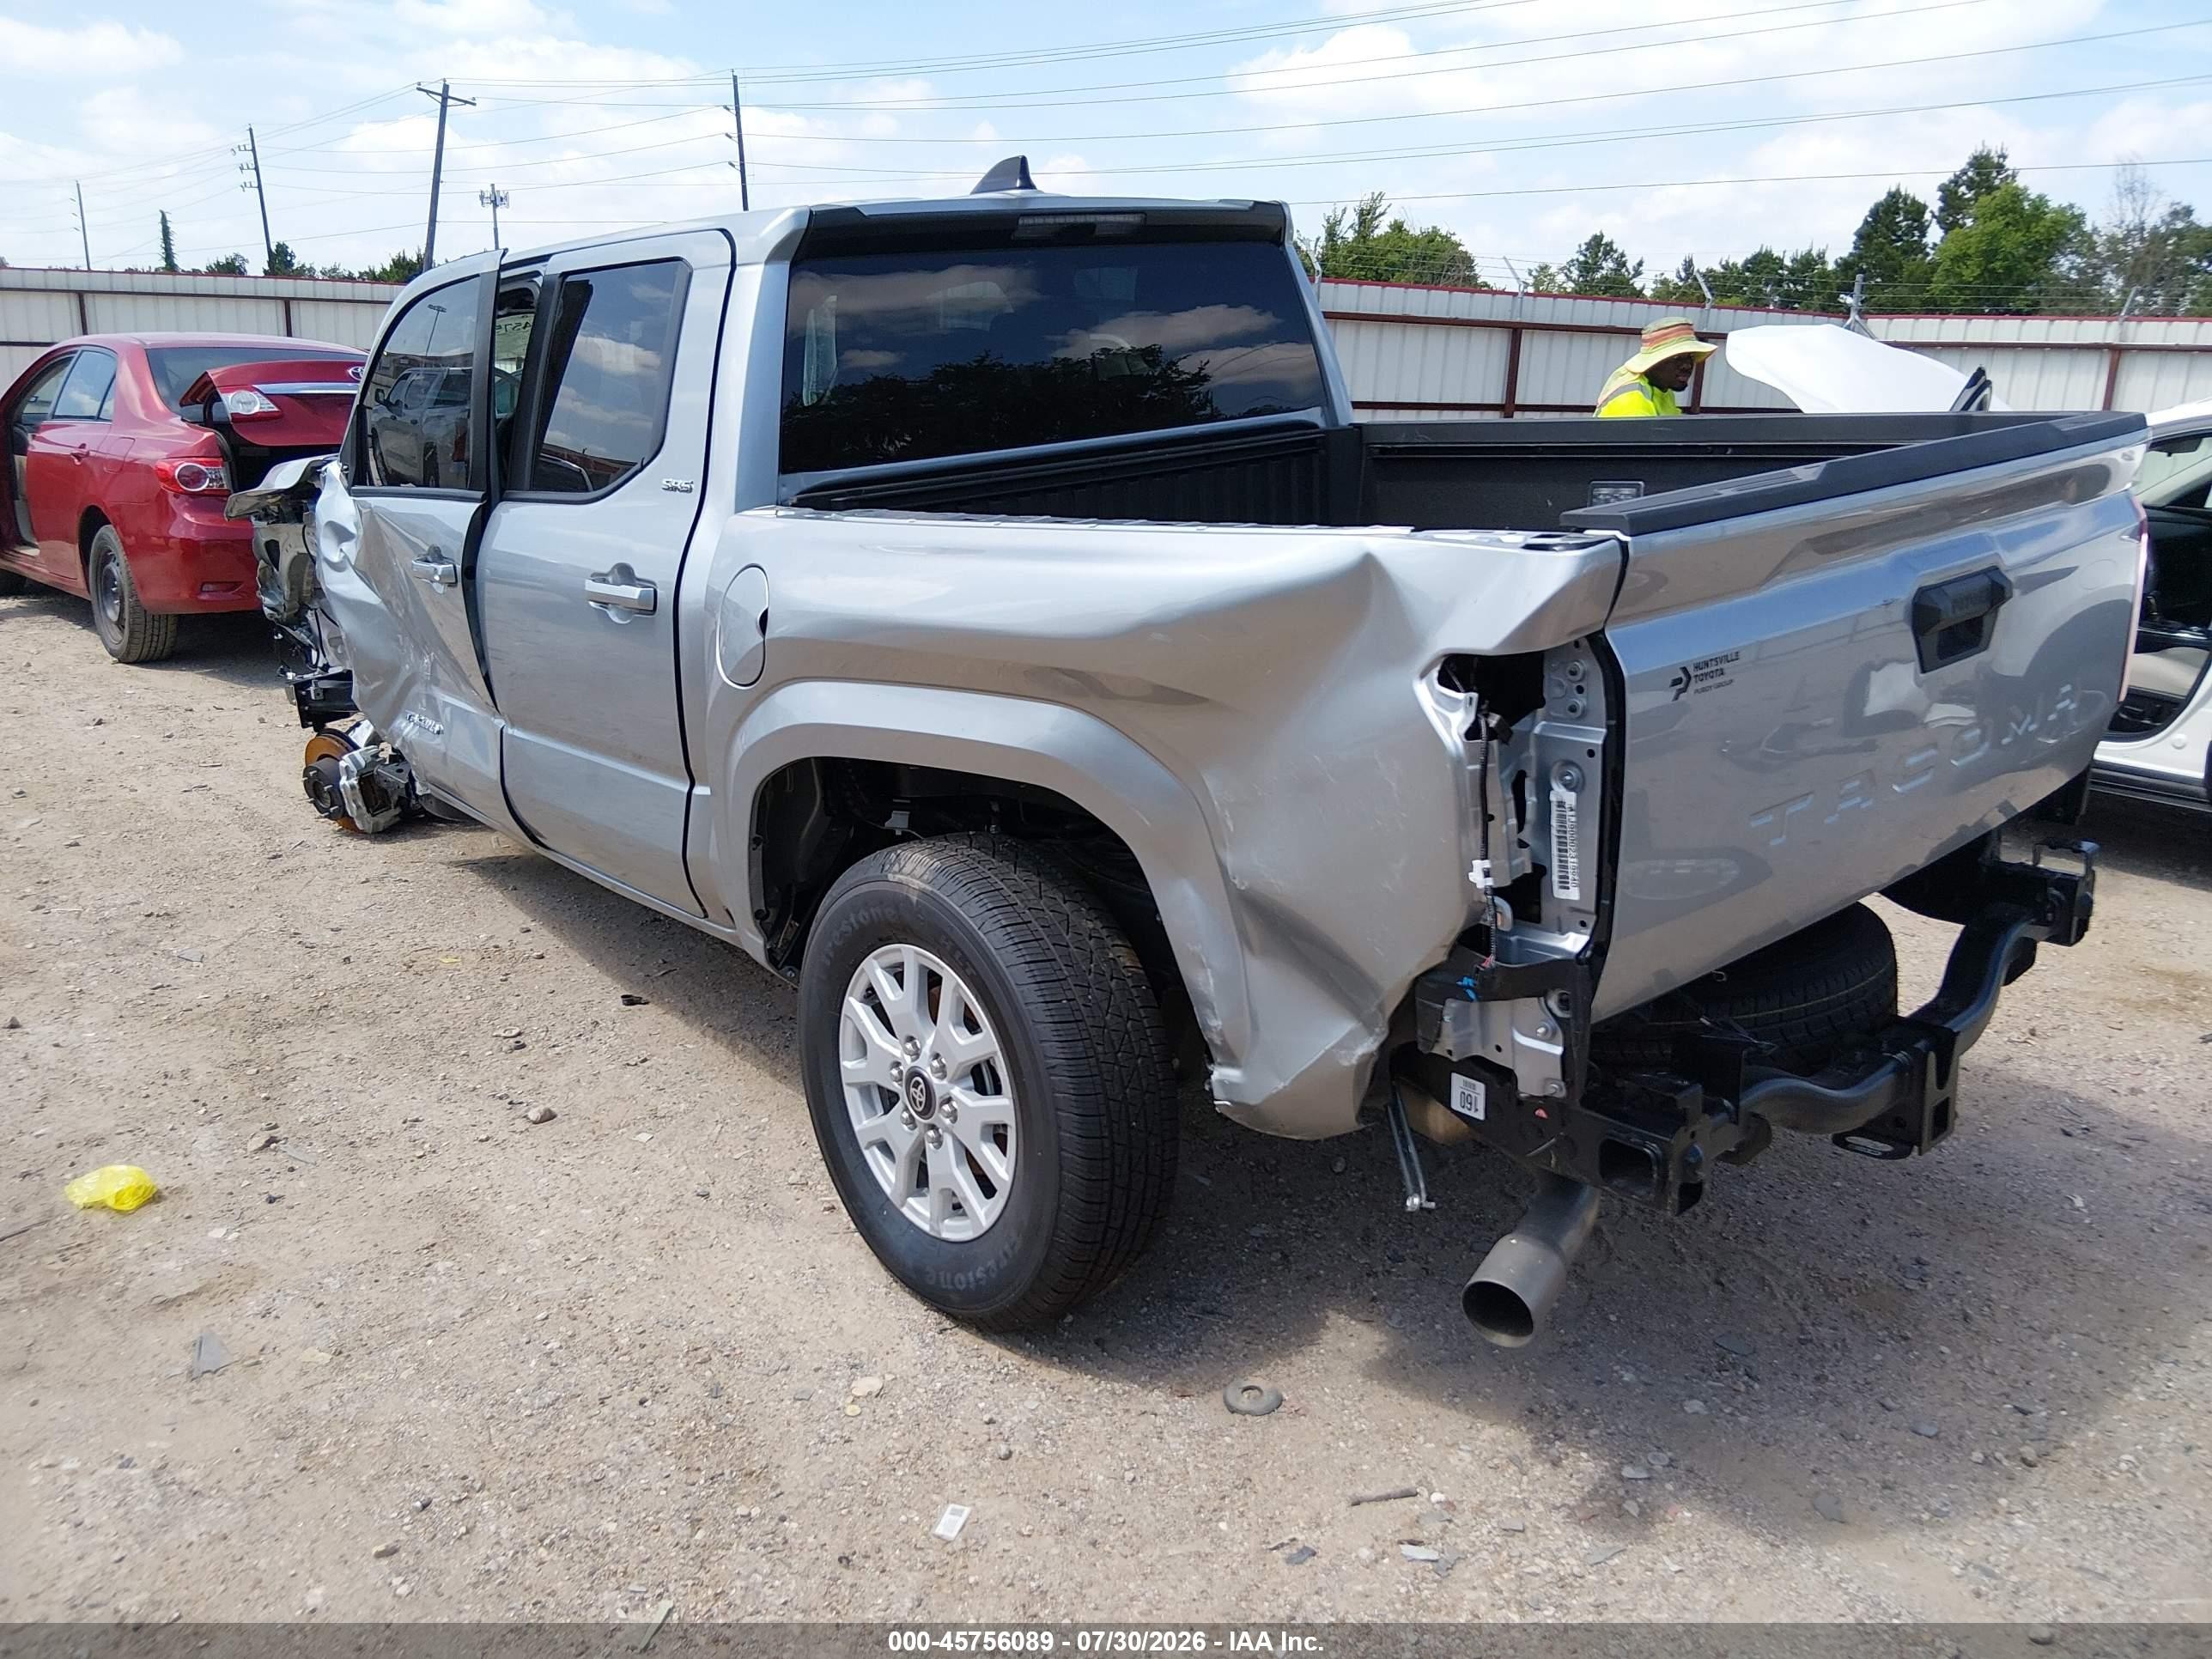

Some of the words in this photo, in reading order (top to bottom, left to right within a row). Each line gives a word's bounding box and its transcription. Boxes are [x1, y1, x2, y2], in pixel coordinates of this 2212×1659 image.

[661, 478, 695, 494] SR5
[1692, 651, 1740, 672] HUNTSVILLE
[1692, 667, 1725, 684] TOYOTA
[1459, 1091, 1480, 1114] 160
